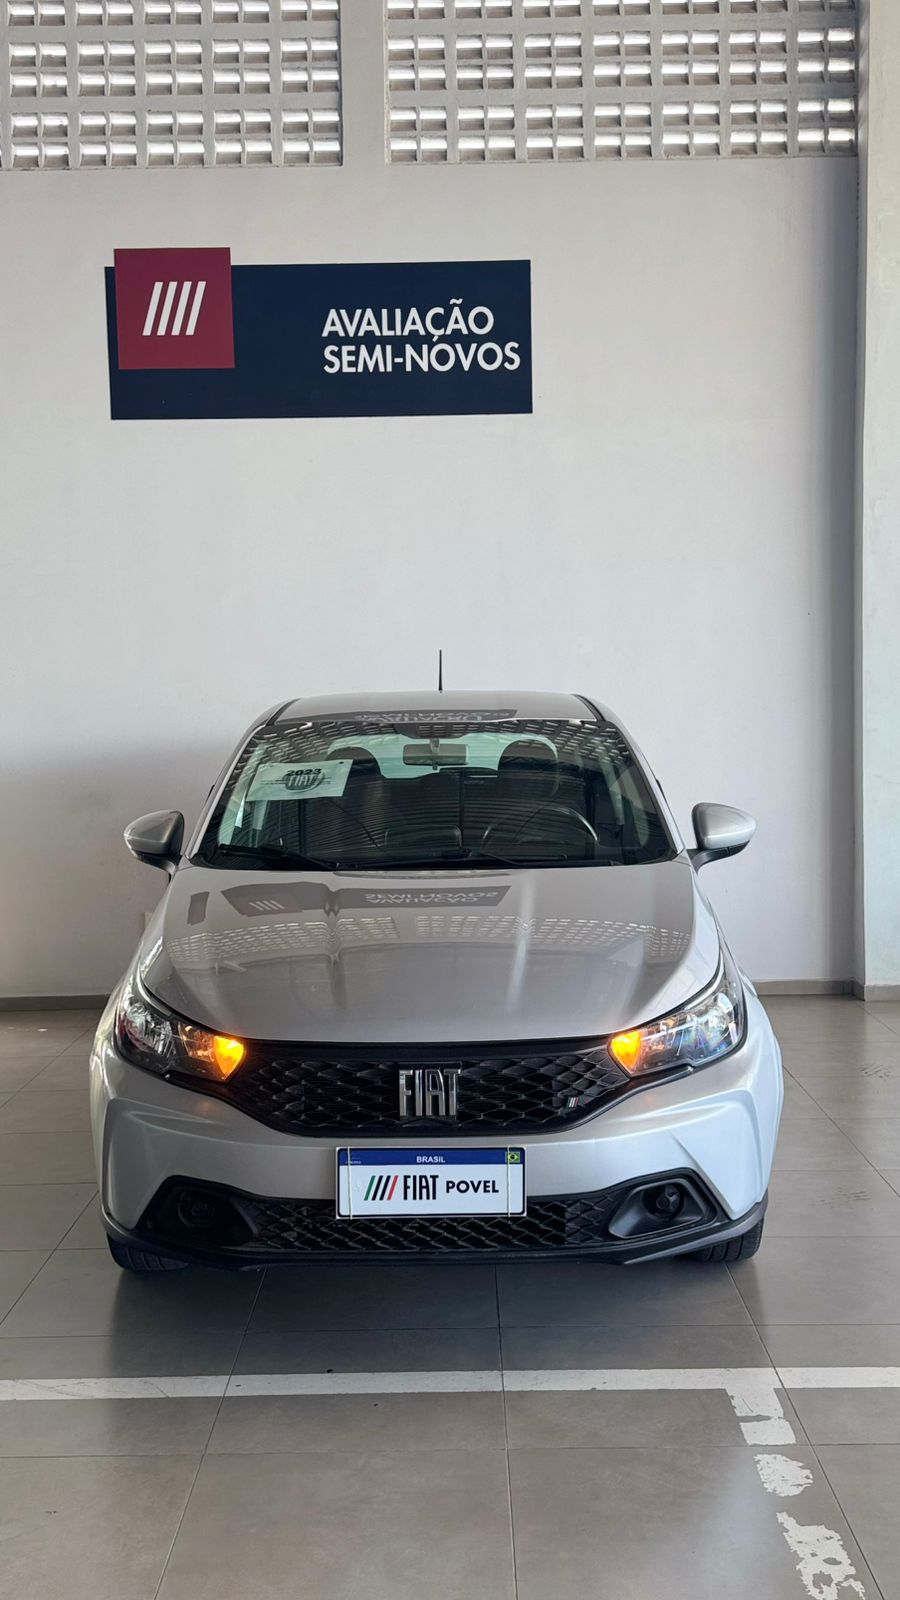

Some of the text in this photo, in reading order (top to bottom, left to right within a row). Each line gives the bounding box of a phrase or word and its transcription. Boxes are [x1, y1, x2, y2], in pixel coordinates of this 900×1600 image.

[321, 298, 495, 341] AVALIAÇÃO
[322, 341, 521, 374] SEMI-NOVOS
[286, 768, 322, 776] 2023
[400, 1069, 461, 1116] FIAT
[403, 1175, 499, 1201] FIAT POVEL
